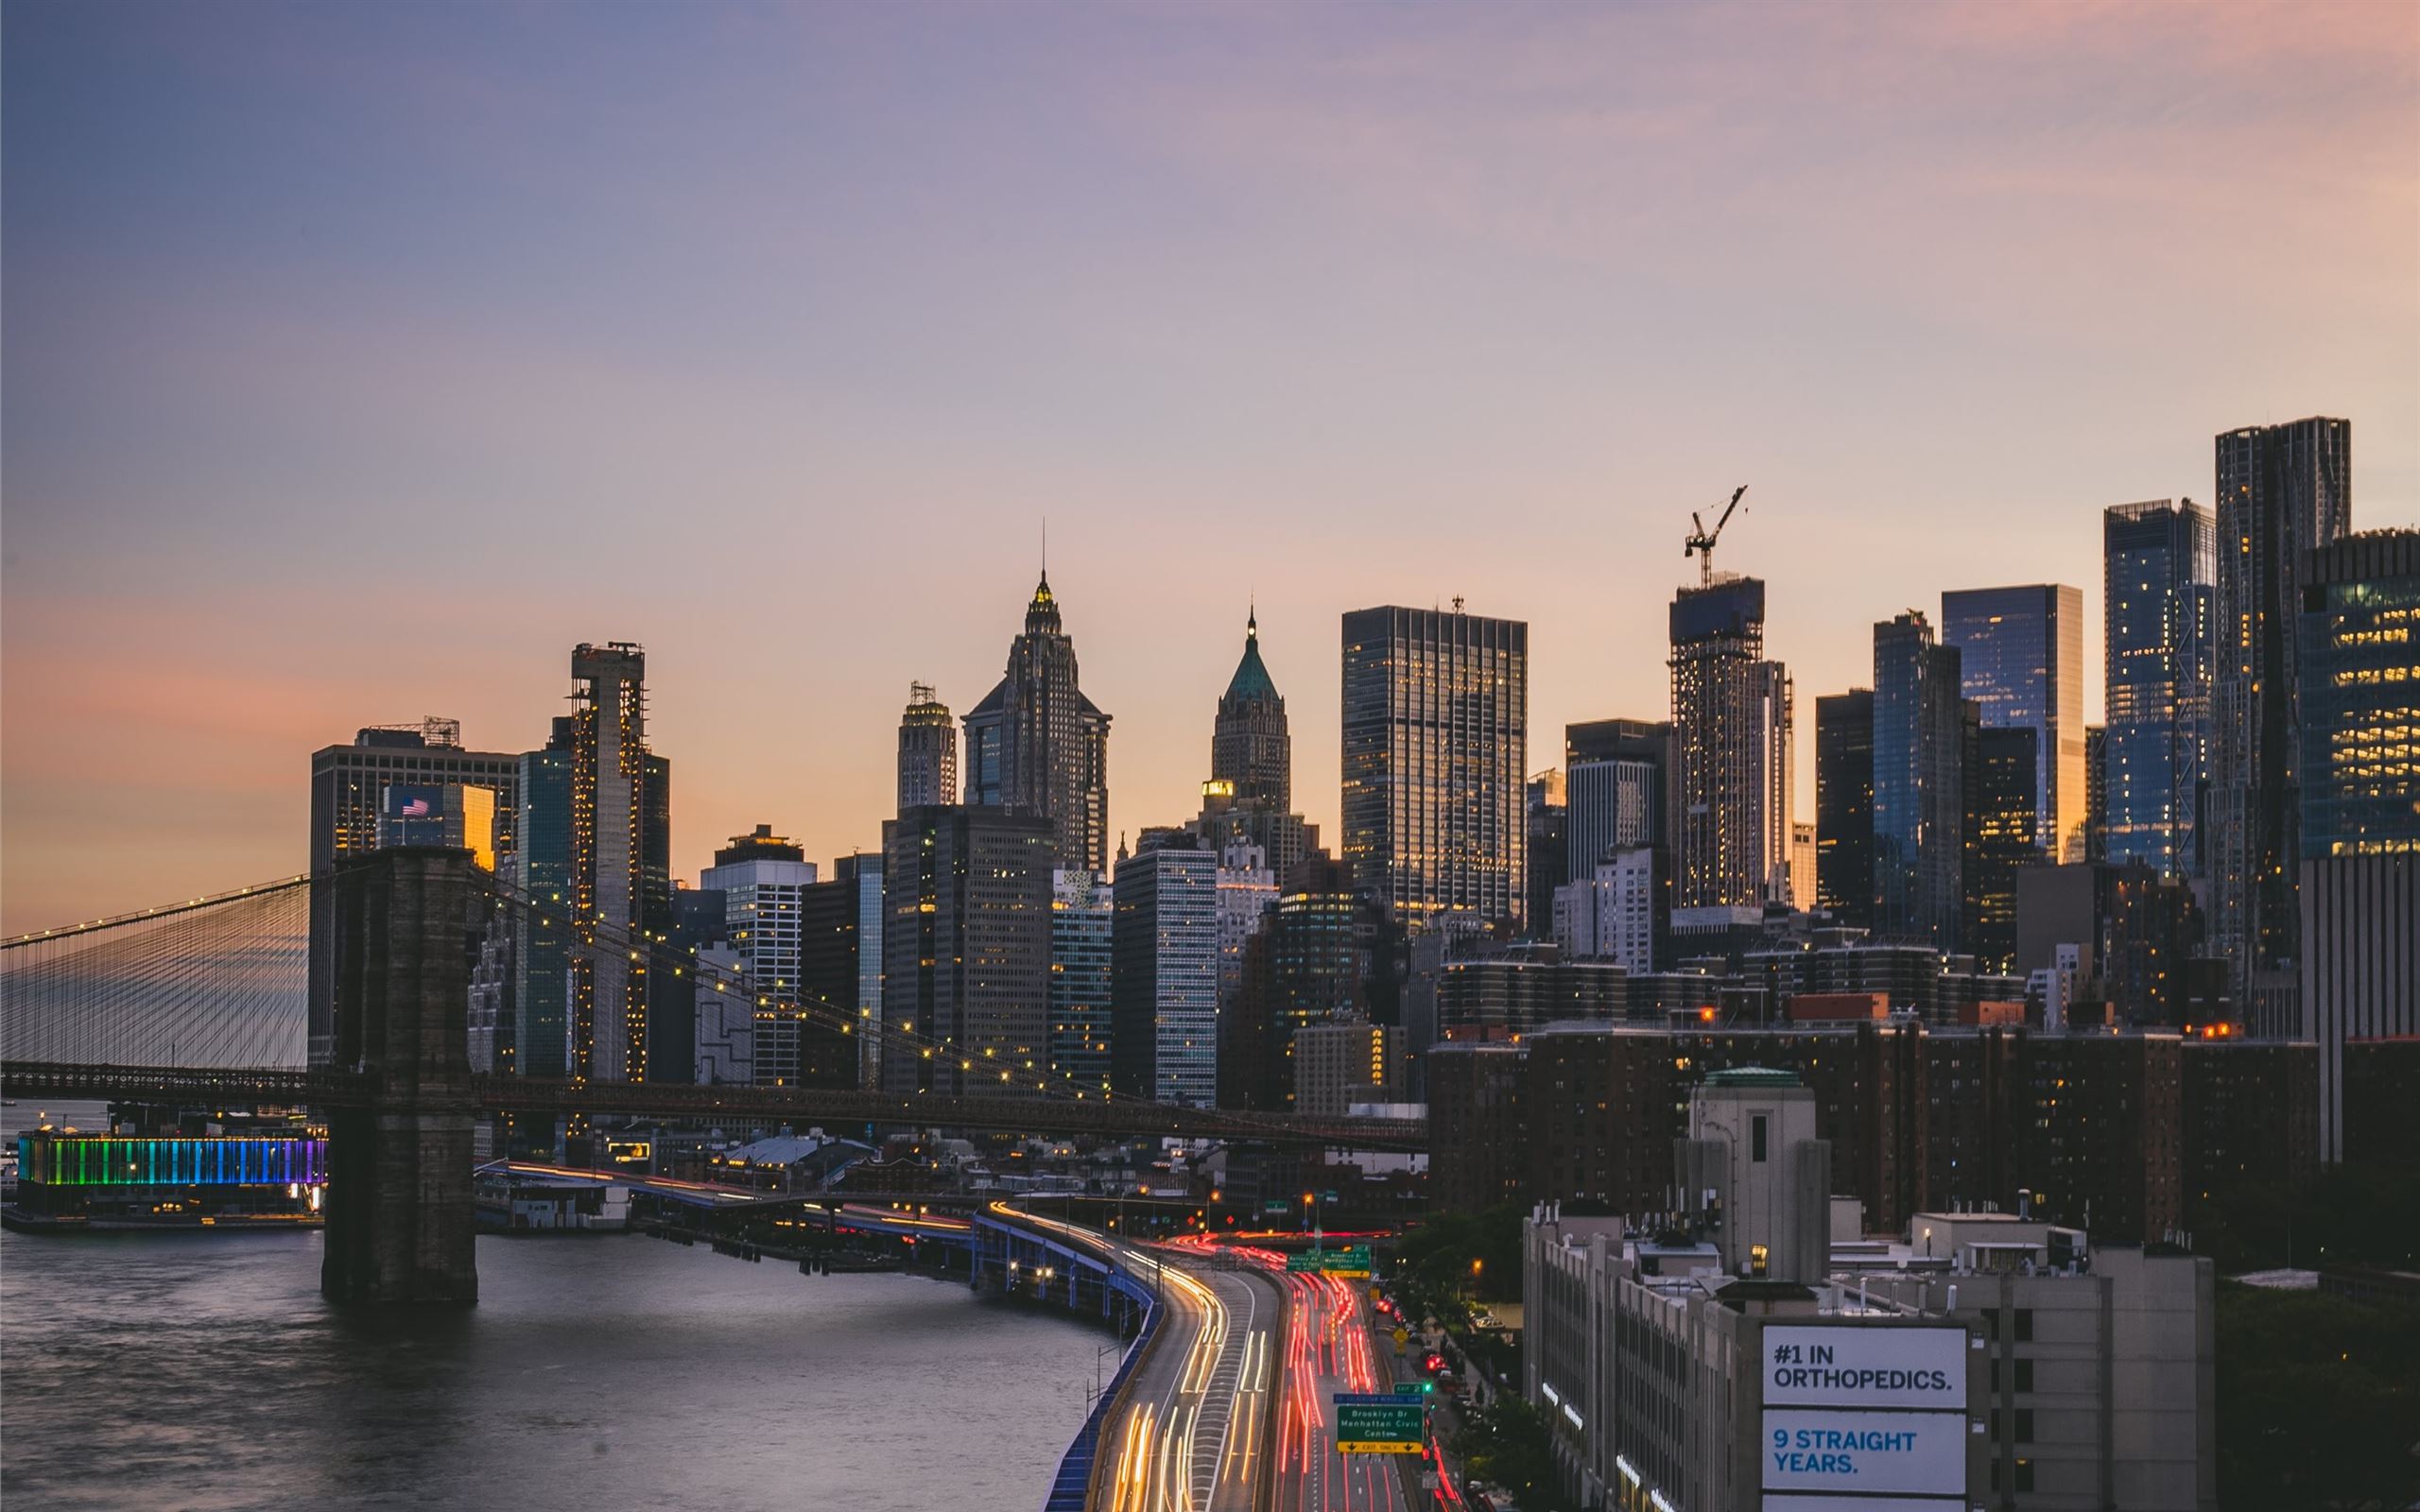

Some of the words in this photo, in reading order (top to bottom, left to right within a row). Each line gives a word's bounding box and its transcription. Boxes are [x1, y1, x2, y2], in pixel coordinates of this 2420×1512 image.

[1773, 1345, 1803, 1365] #1
[1809, 1346, 1834, 1366] IN
[1413, 1384, 1421, 1393] 2
[1773, 1367, 1953, 1391] ORTHOPEDICS.
[1352, 1410, 1393, 1418] Brooklyn
[1395, 1419, 1419, 1428] Civic
[1773, 1429, 1789, 1449] 9
[1796, 1430, 1917, 1452] STRAIGHT
[1773, 1452, 1858, 1474] YEARS.
